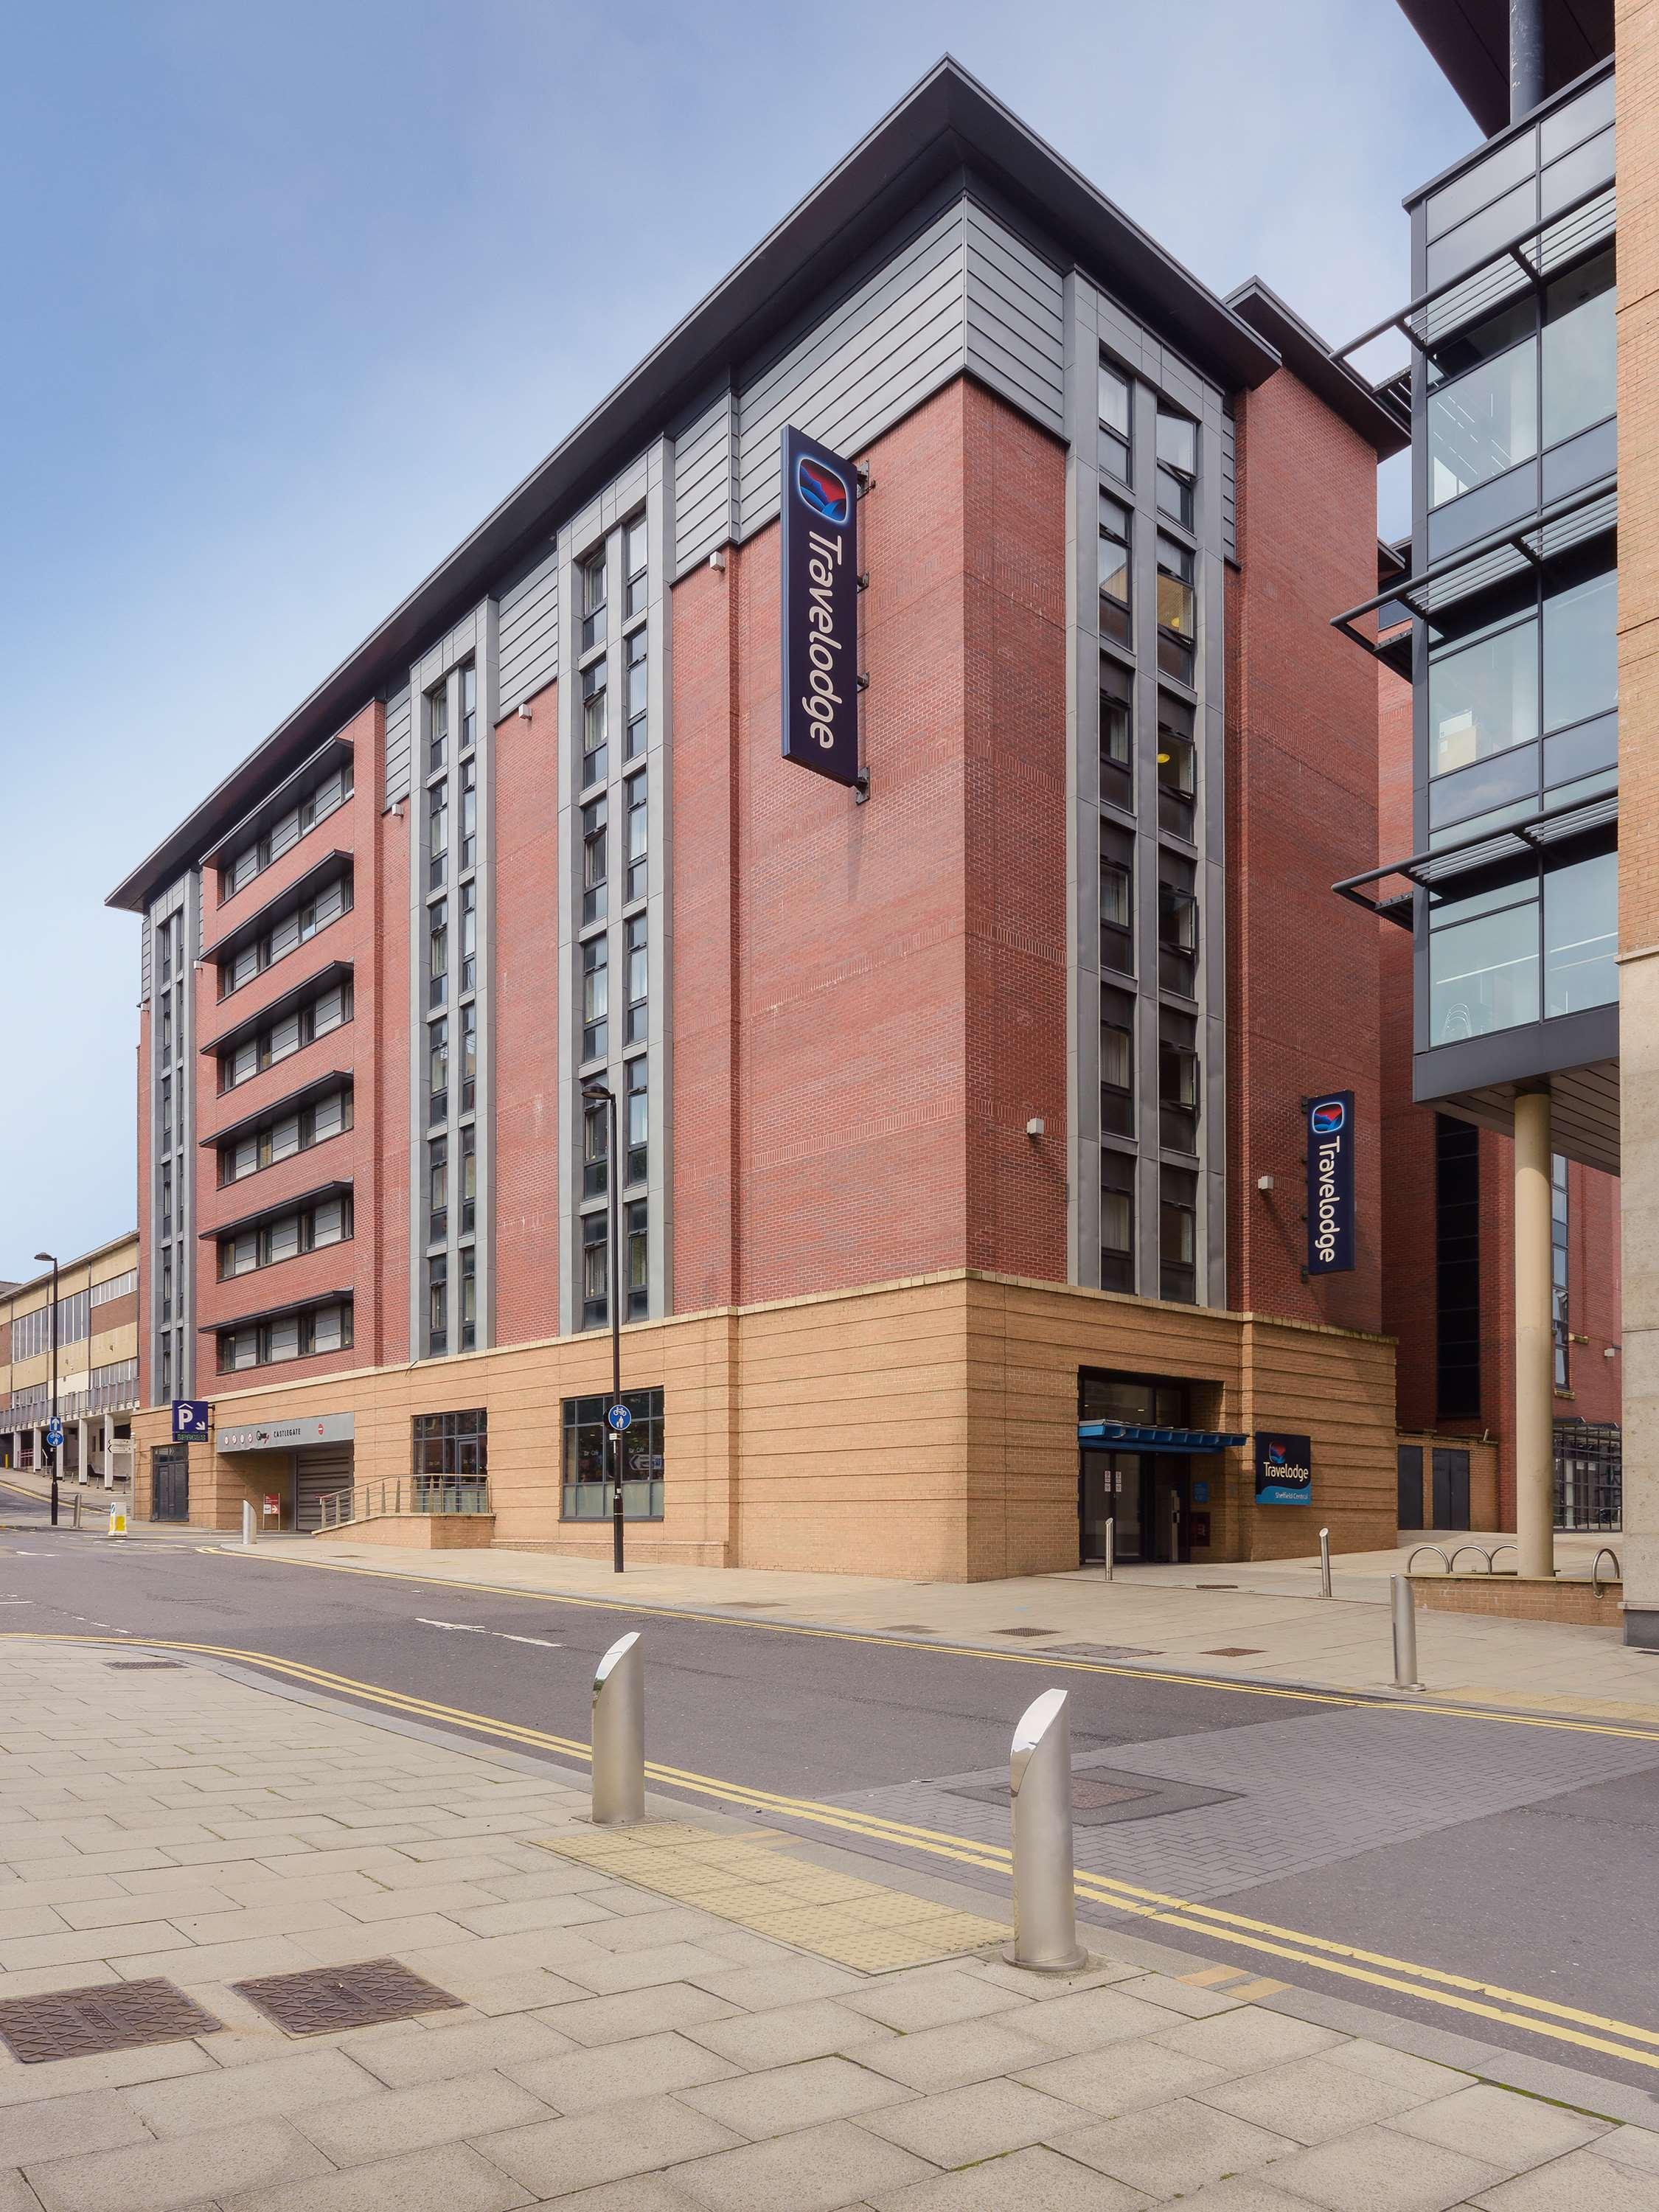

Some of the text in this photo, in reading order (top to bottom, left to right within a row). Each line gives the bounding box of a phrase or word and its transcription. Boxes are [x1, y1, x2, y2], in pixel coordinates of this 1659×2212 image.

[801, 530, 842, 749] Travelodge
[1314, 1135, 1340, 1263] Travelodge
[178, 1409, 193, 1430] P
[274, 1428, 301, 1438] CASTLEGATE
[1263, 1462, 1309, 1482] Travelodge
